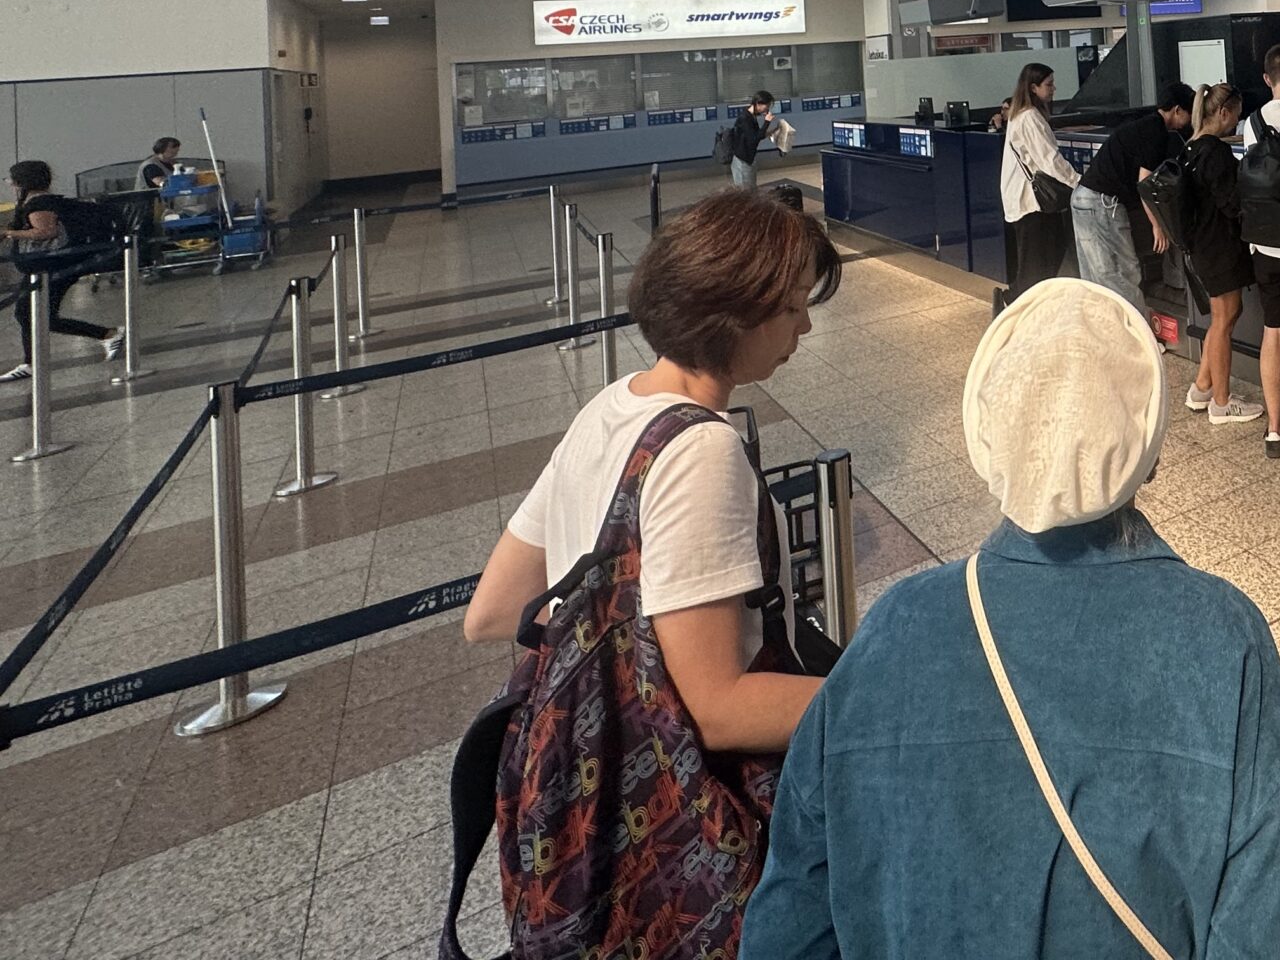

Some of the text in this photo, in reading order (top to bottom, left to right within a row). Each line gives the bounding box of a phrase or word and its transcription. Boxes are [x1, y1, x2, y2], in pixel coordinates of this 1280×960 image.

[580, 14, 625, 25] CZECH
[686, 10, 781, 23] smartwings
[578, 24, 643, 35] AIRLINES
[442, 581, 478, 597] Pragu
[442, 590, 475, 605] Airpo
[83, 692, 133, 711] Praha
